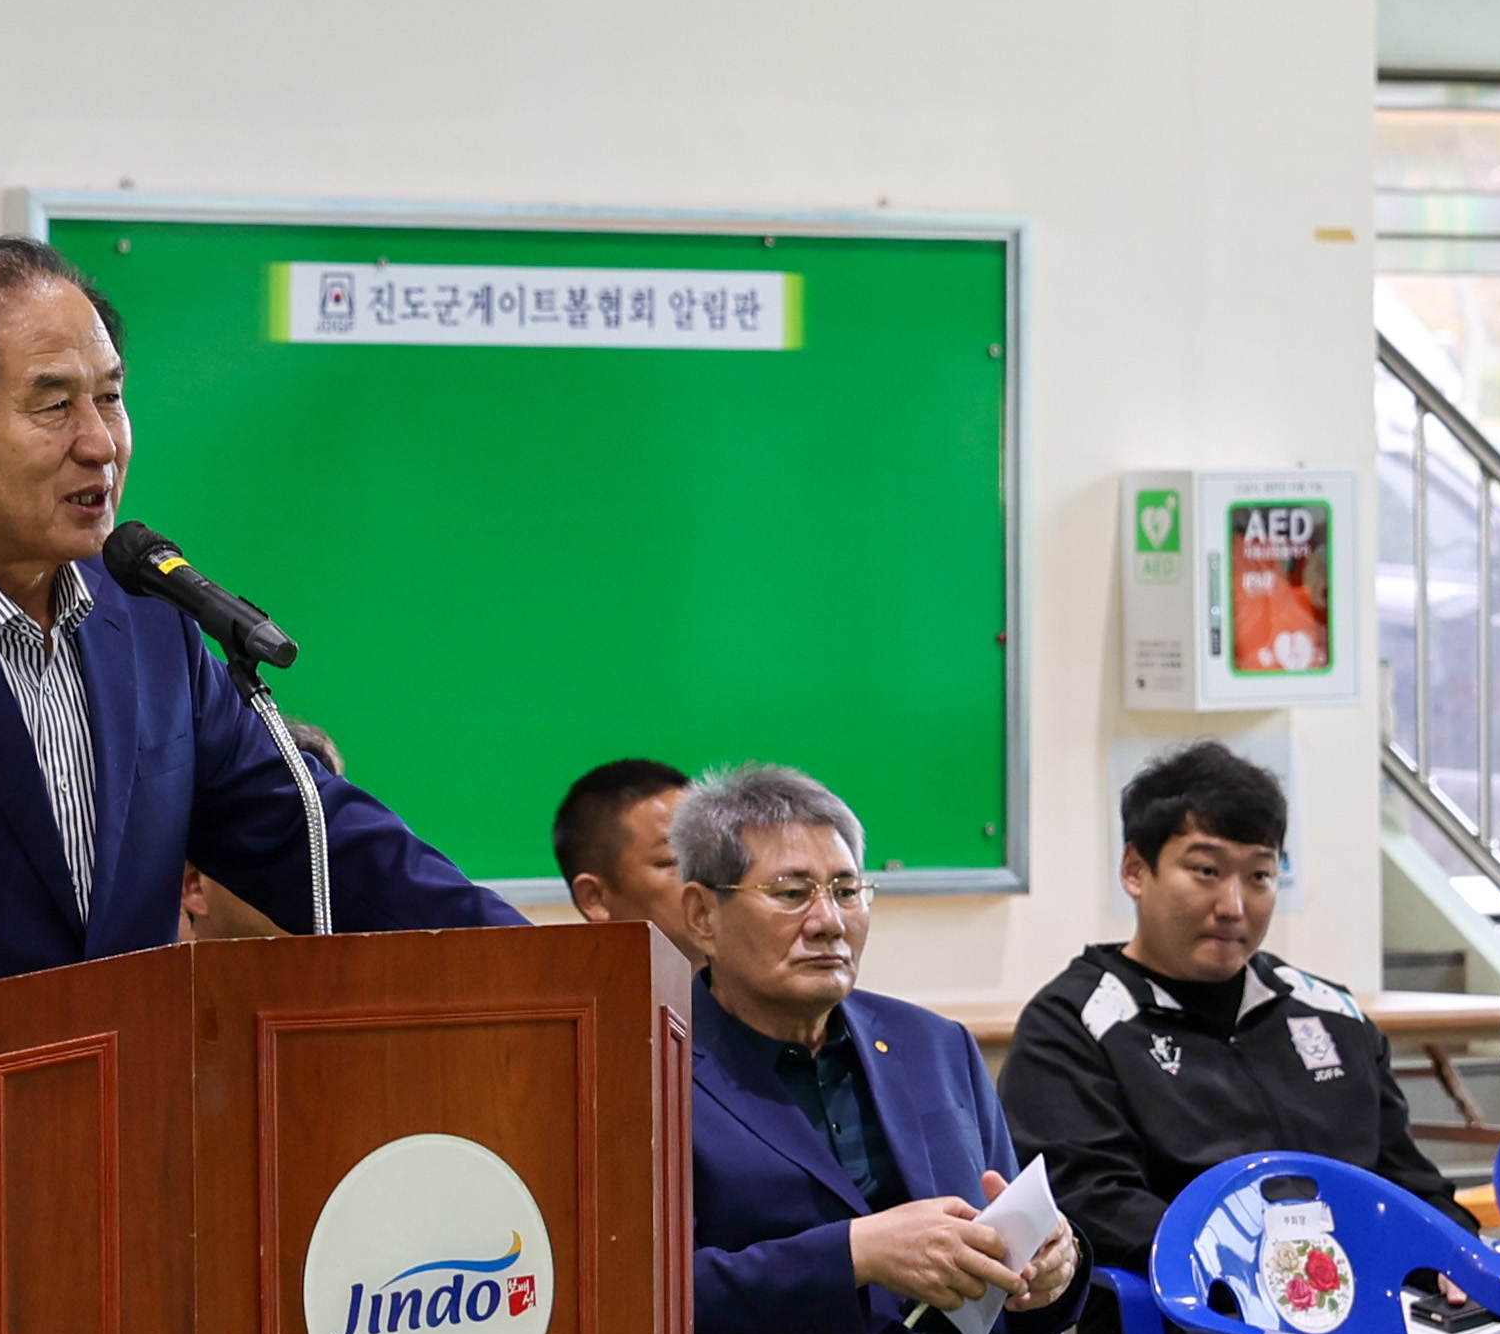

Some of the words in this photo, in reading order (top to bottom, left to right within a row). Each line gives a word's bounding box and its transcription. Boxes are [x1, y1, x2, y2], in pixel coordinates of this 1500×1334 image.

[367, 280, 656, 329] 진도군게이트볼협회
[668, 286, 761, 331] 알림판
[1244, 507, 1313, 544] AED
